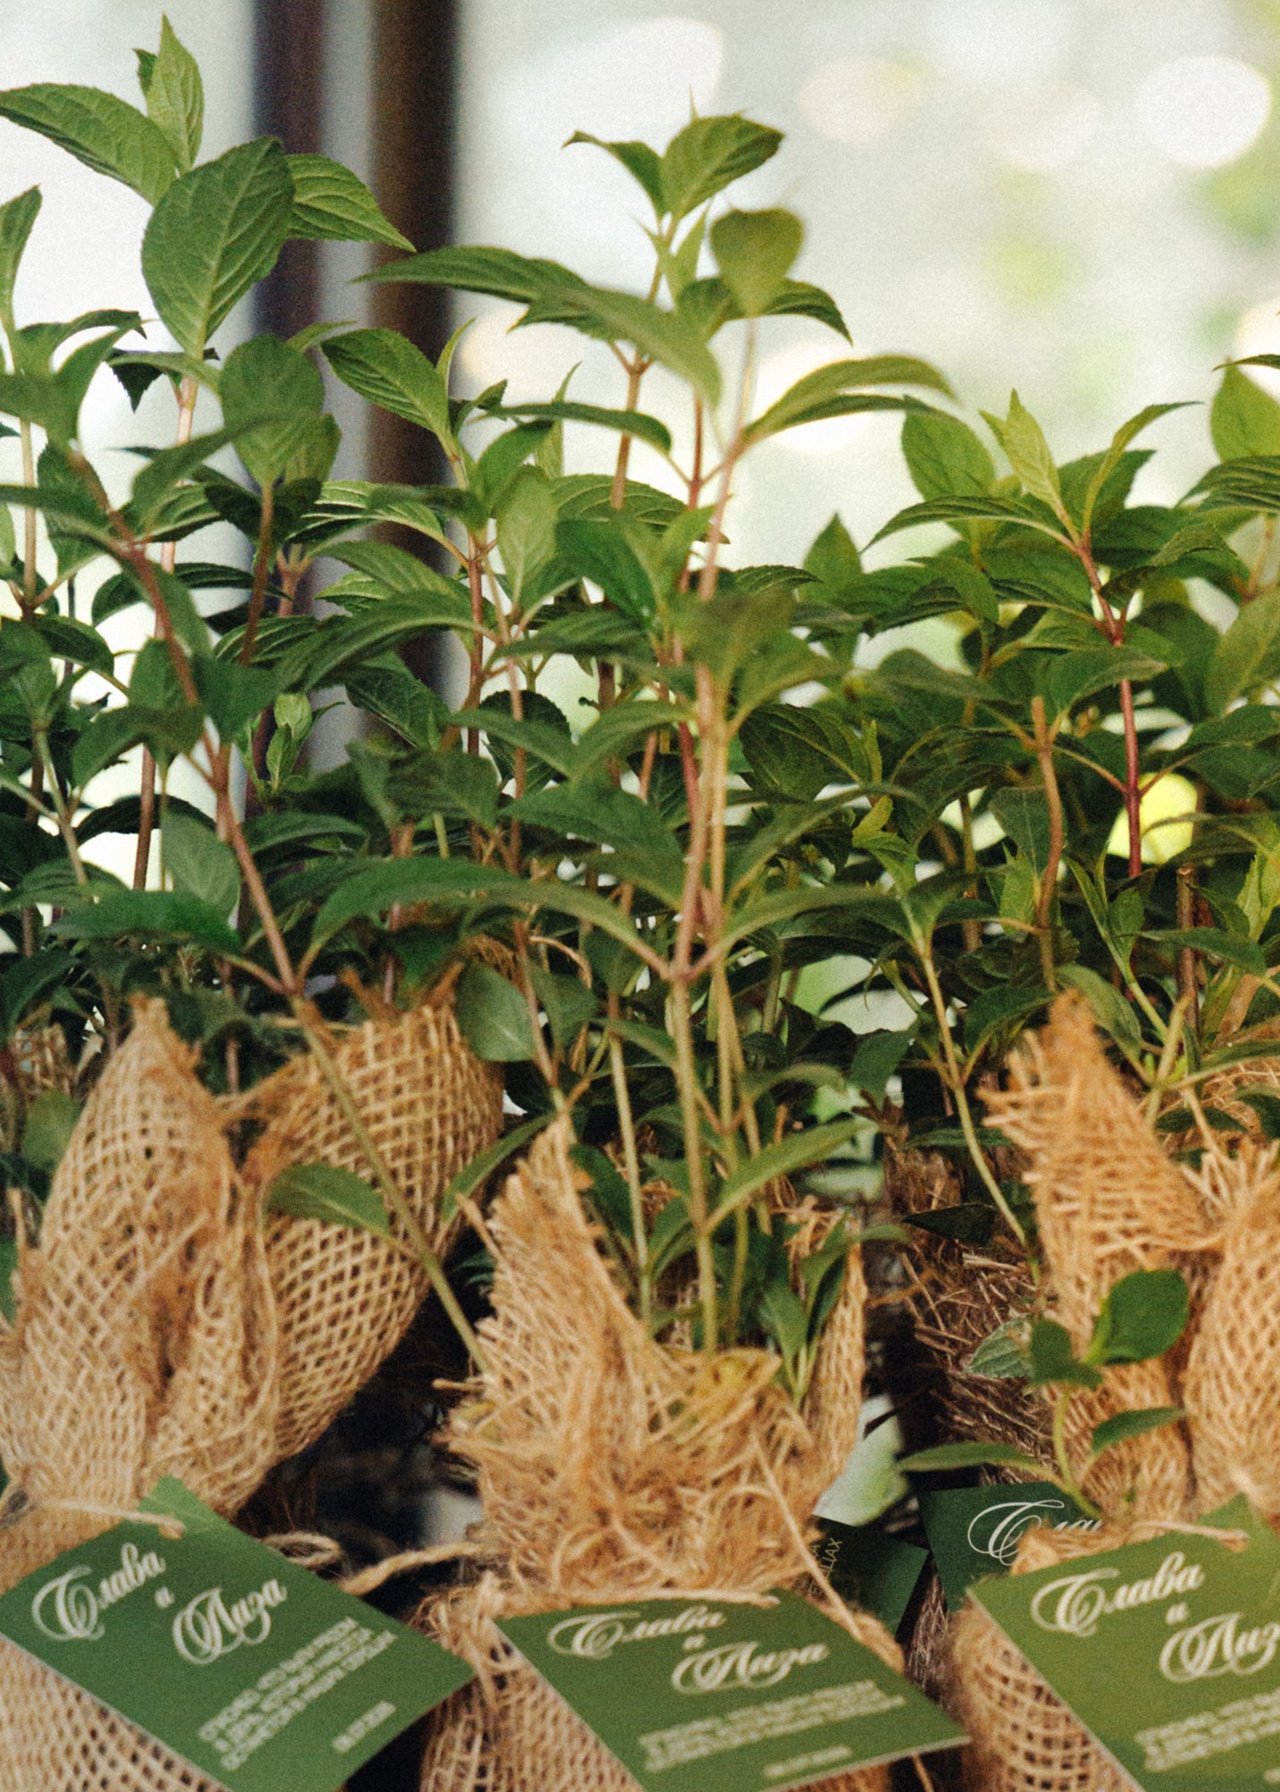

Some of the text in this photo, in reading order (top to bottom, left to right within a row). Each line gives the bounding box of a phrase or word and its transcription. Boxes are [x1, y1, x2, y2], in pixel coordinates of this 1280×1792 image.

[31, 1542, 166, 1641] Слава
[172, 1579, 288, 1665] Лиза
[547, 1605, 727, 1660] Слава
[1030, 1551, 1205, 1638] Слава
[671, 1641, 830, 1695] Лиза
